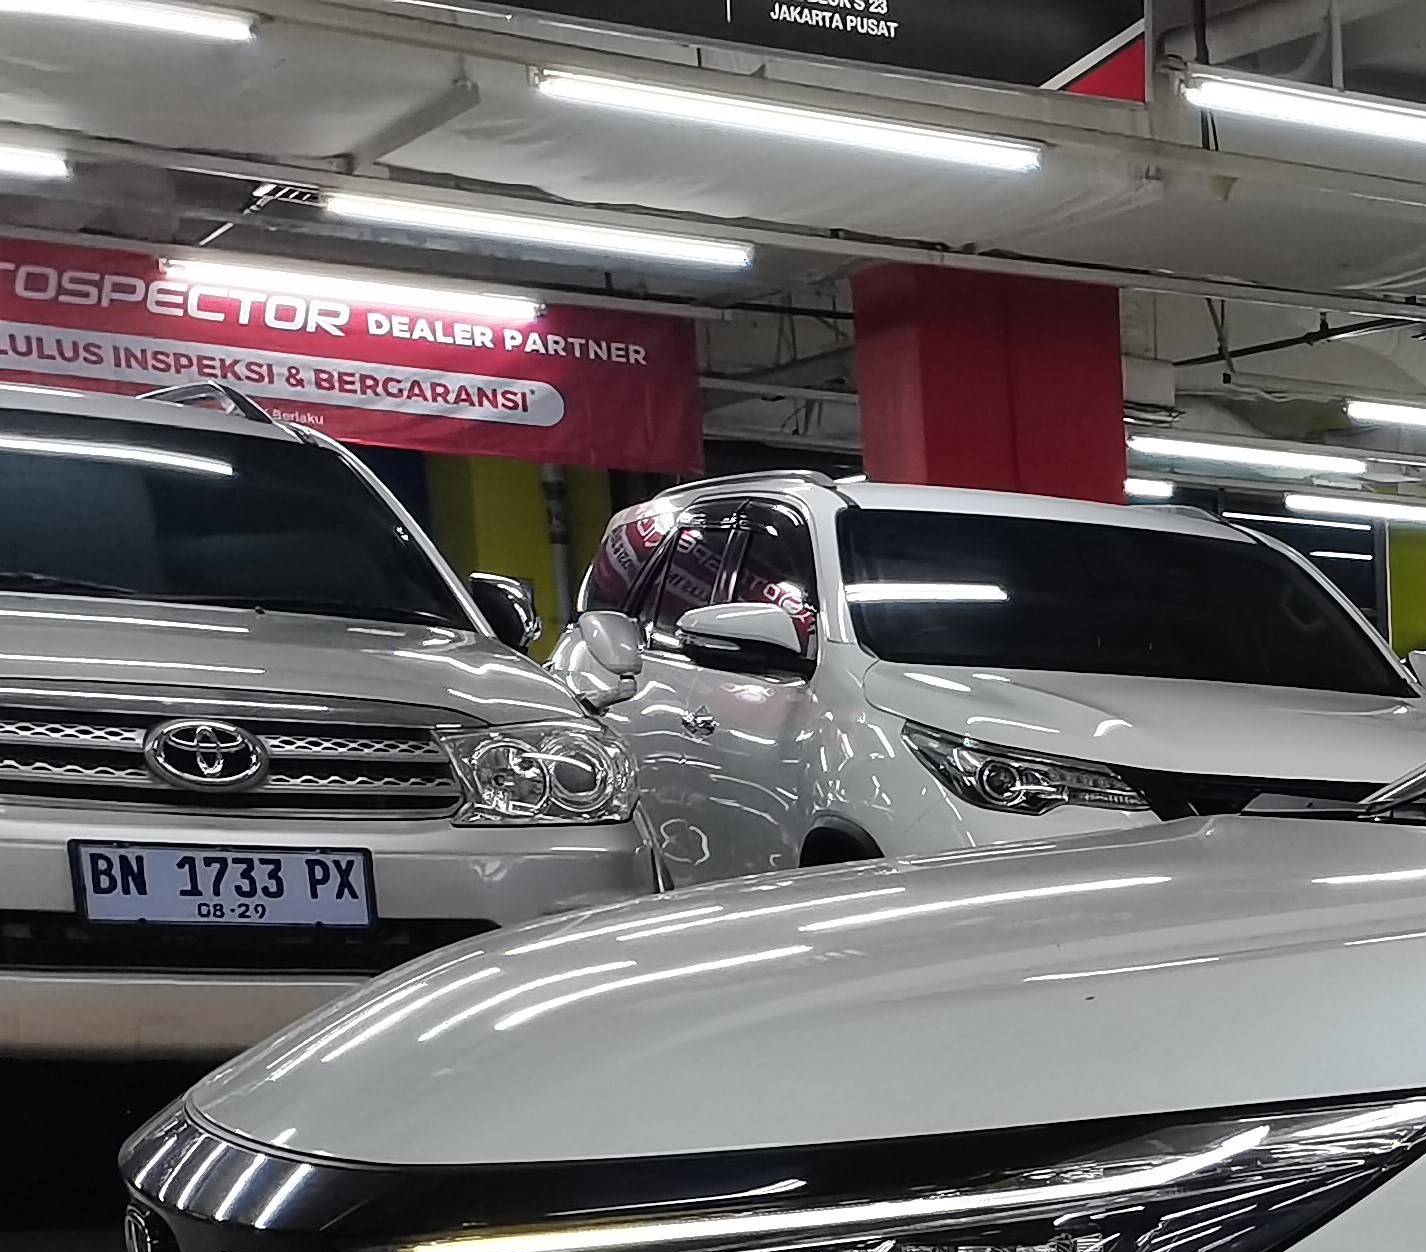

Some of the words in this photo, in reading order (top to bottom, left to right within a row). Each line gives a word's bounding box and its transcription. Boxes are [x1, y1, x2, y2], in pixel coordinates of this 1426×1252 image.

[769, 2, 844, 30] JAKARTA
[846, 15, 899, 38] PUSAT
[868, 0, 888, 14] 23
[0, 262, 351, 337] OSPECTOR
[366, 312, 495, 349] DEALER
[503, 328, 648, 366] PARTNER
[112, 345, 275, 385] INSPEKSI
[284, 365, 306, 389] &
[272, 408, 324, 425] Berlaku
[88, 852, 149, 896] BN
[175, 856, 285, 899] 1733
[304, 858, 360, 900] PX
